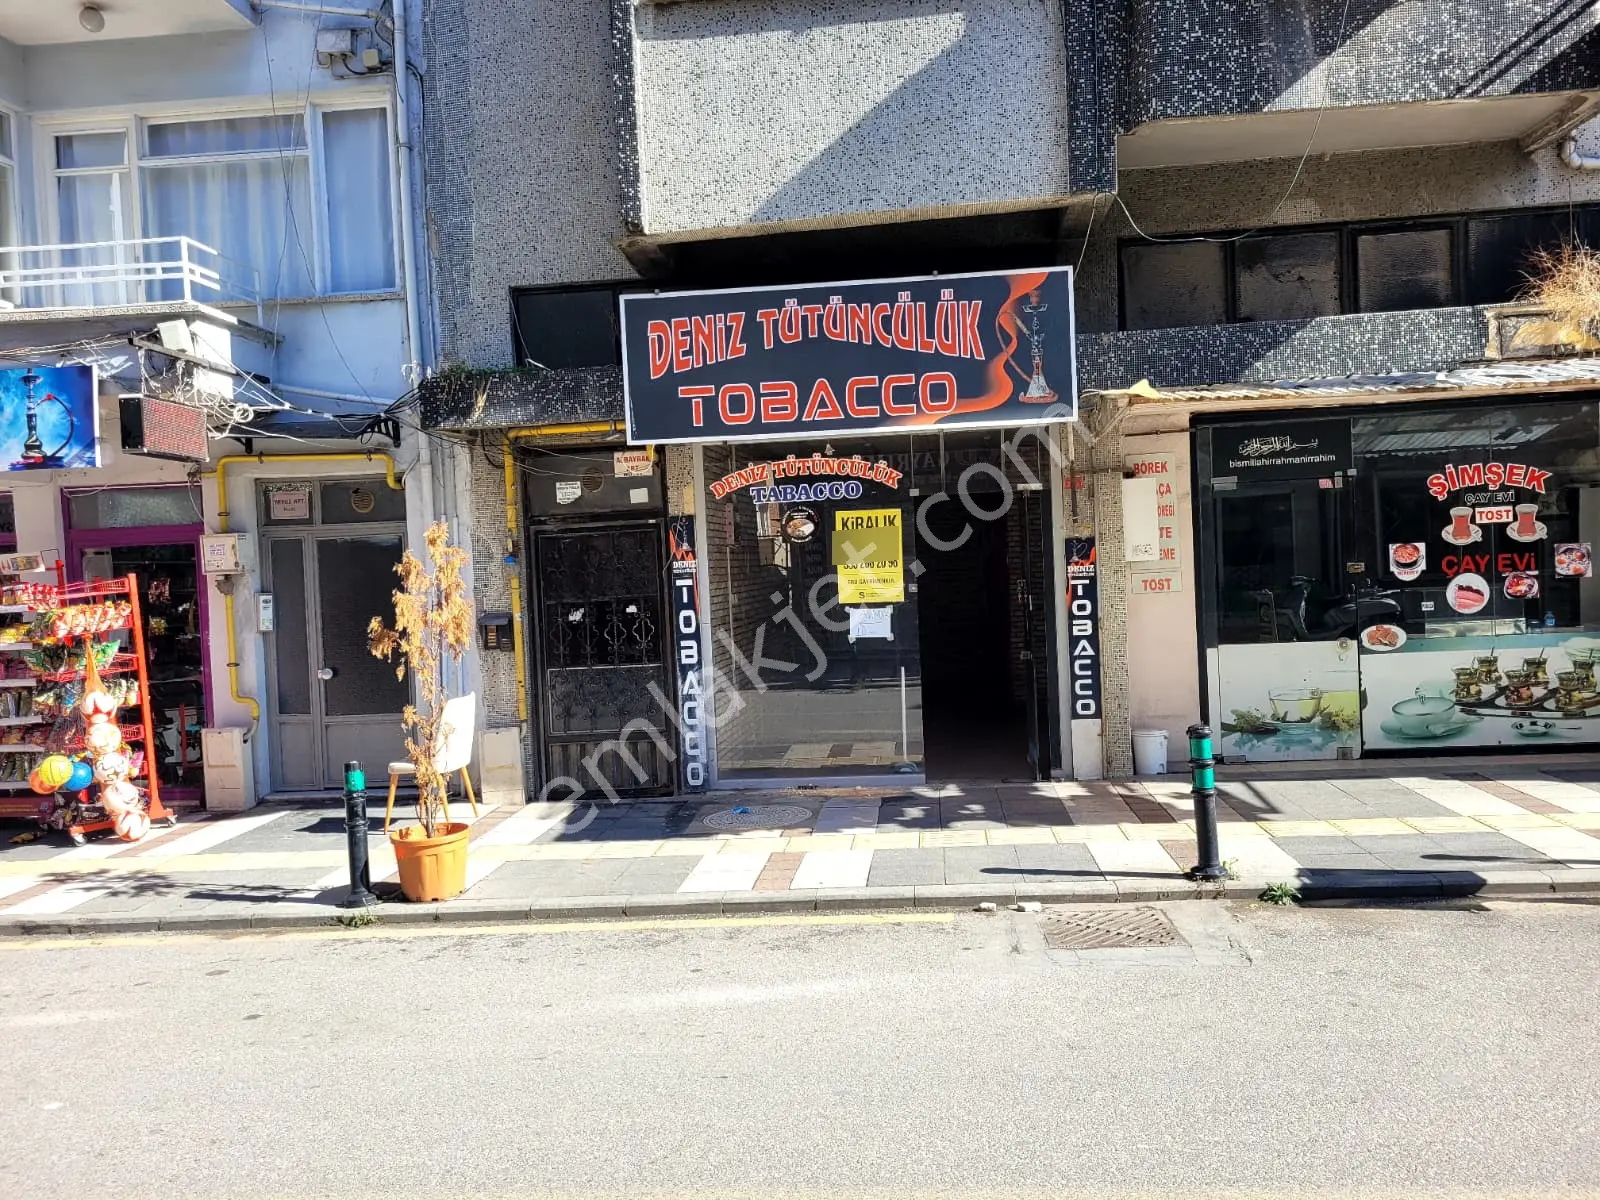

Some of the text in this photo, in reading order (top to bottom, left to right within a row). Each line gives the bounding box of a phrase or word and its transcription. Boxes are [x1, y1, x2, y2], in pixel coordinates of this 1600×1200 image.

[757, 288, 986, 361] TÜTÜNCÜLÜK
[678, 371, 958, 427] TOBACCO
[1132, 460, 1168, 475] BÖREK
[1229, 454, 1336, 468] bismillahirrahmanirrahim
[710, 453, 903, 500] DENİZ TÜTÜNCÜLÜK
[1426, 463, 1553, 501] ŞİMŞEK
[750, 481, 863, 505] TABACCO
[1156, 482, 1172, 499] ÇA
[1465, 493, 1490, 505] ÇAY
[1477, 509, 1512, 522] TOST
[1159, 527, 1172, 539] TE
[1441, 555, 1490, 578] ÇAY
[1142, 578, 1172, 591] TOST
[1071, 579, 1096, 715] TOBACCO
[676, 579, 704, 787] TOBACCO
